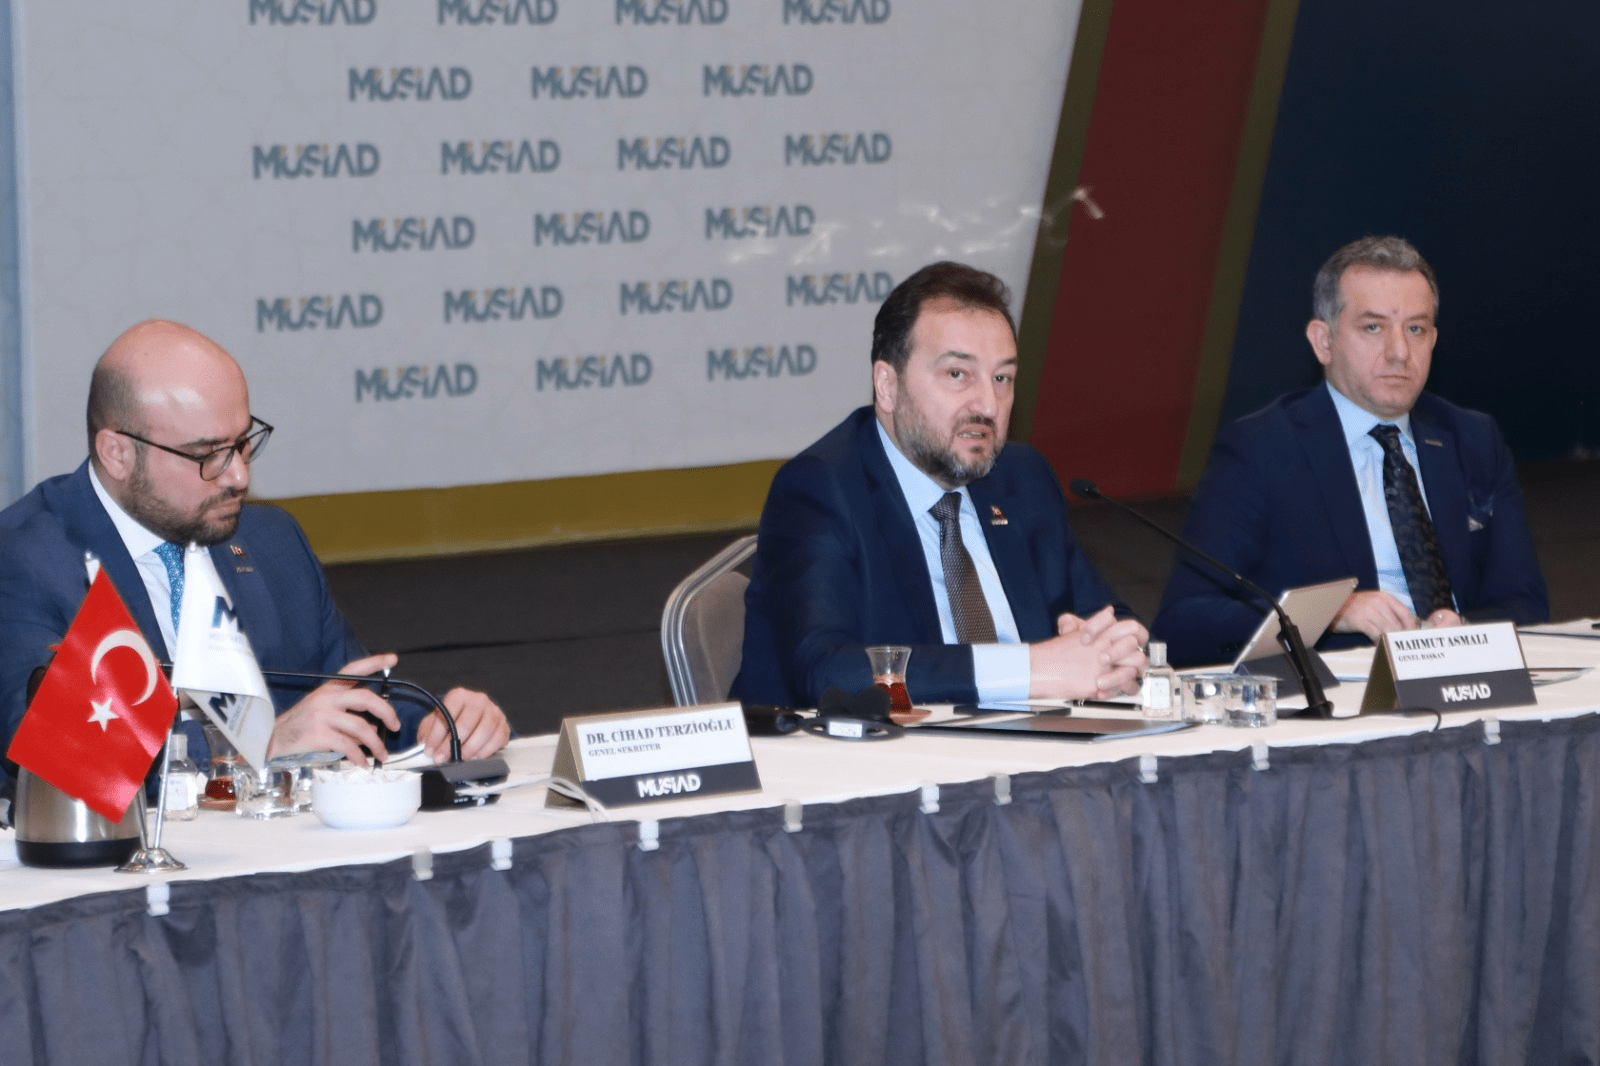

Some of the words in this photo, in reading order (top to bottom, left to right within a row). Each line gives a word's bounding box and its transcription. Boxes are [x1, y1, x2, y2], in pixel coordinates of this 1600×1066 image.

[1395, 637, 1445, 651] MAHMUT
[1447, 633, 1489, 648] ASMALI
[1398, 653, 1420, 662] GENEL
[586, 731, 609, 745] DR.
[610, 727, 655, 742] CİHAD
[655, 718, 736, 738] TERZİOĞLU
[588, 747, 617, 757] GENEL
[617, 742, 662, 755] SEKRETER
